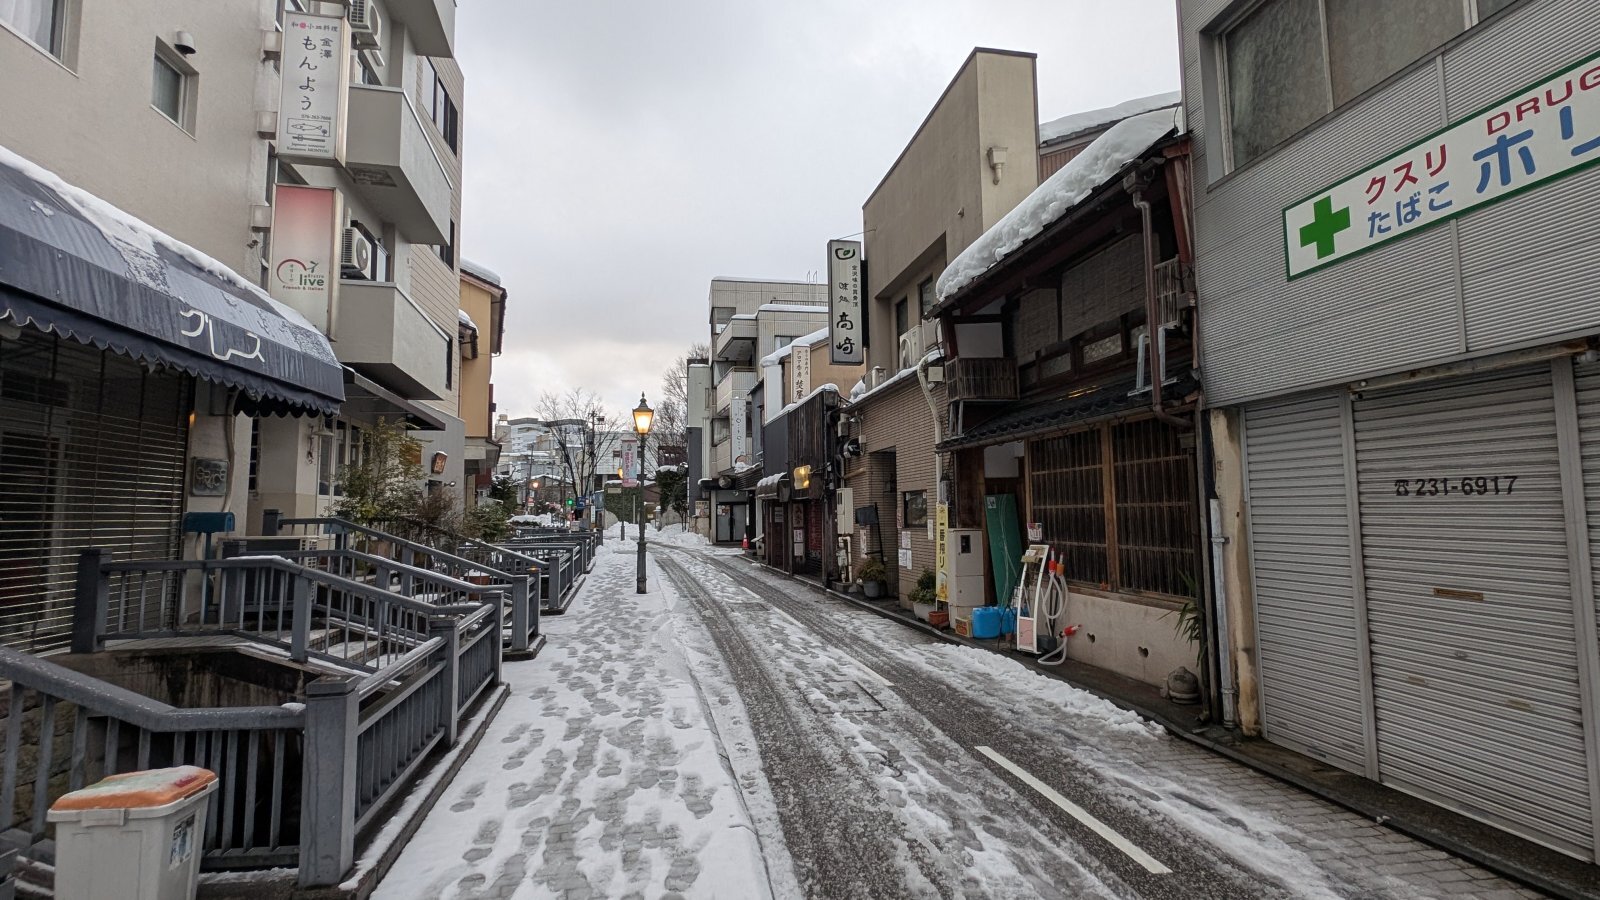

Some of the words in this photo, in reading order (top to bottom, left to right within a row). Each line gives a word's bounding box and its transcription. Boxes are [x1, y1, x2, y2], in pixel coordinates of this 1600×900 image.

[299, 35, 318, 111] もんよう
[320, 37, 333, 58] 金澤
[1487, 65, 1600, 136] DRUG
[1365, 144, 1447, 205] クスリ
[1367, 180, 1453, 238] たばこ
[1415, 475, 1519, 497] 231-6917
